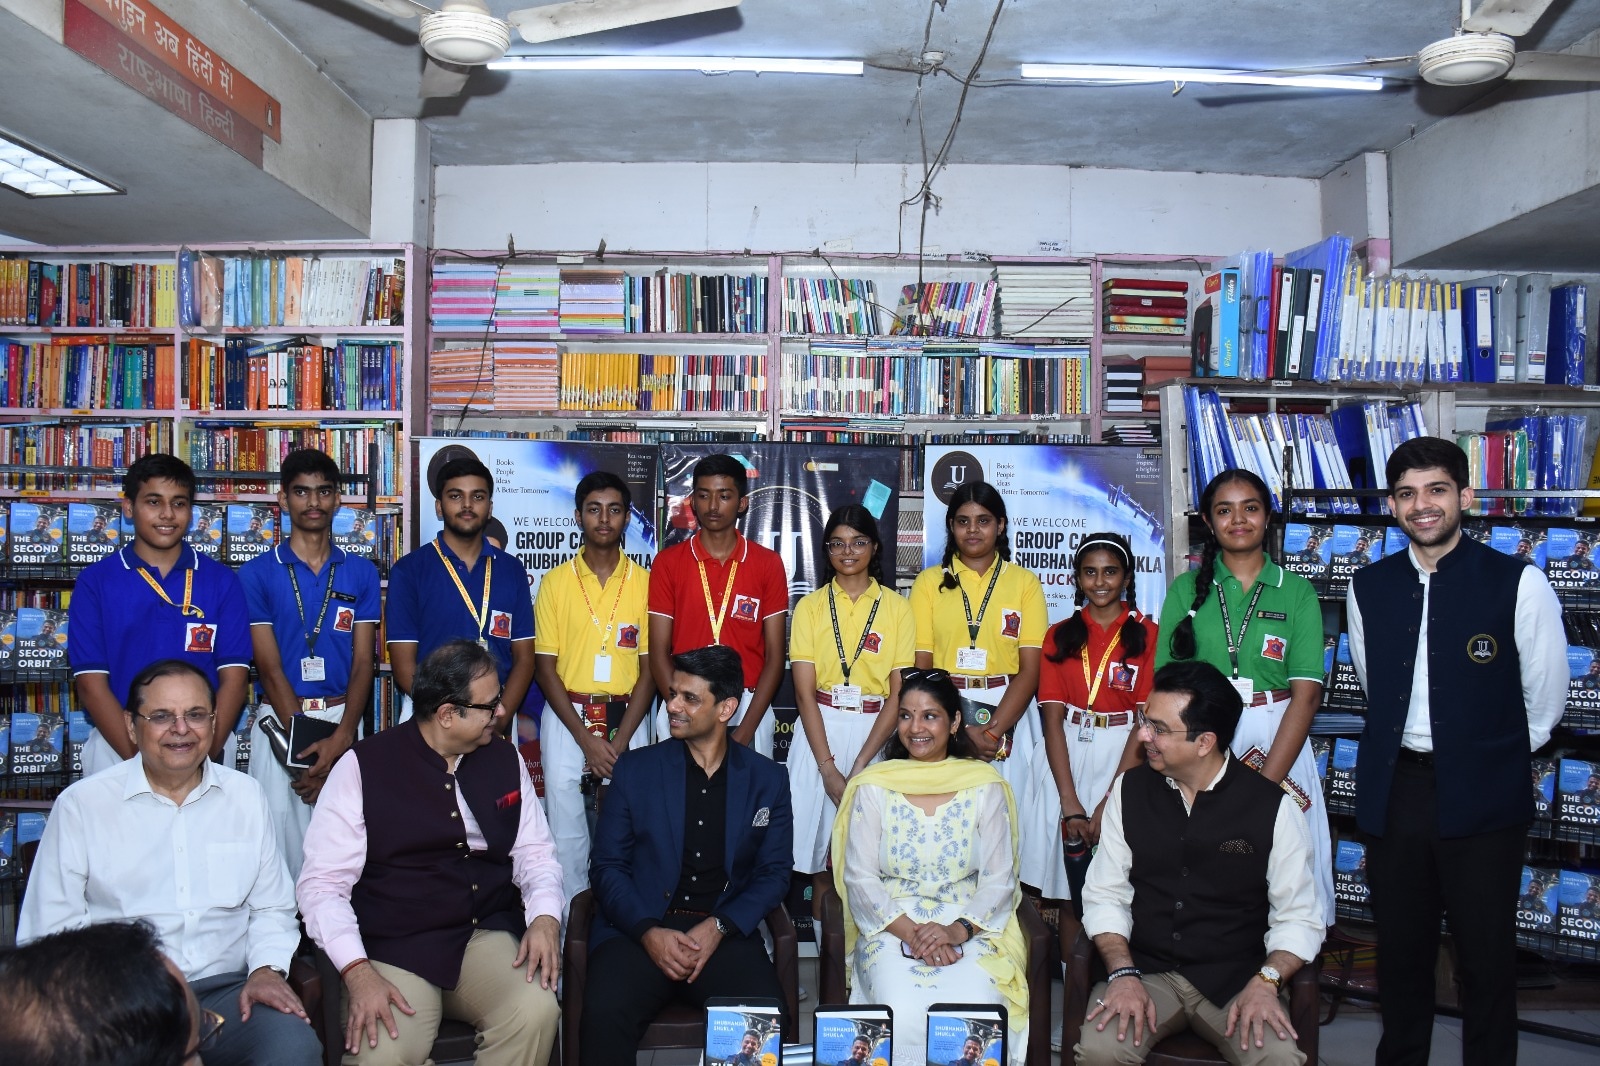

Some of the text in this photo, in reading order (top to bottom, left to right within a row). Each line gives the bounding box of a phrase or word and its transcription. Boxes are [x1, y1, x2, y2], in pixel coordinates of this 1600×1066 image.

[154, 21, 180, 60] अब
[185, 37, 213, 86] हिंदी
[496, 468, 514, 476] People
[950, 466, 967, 484] U
[514, 517, 578, 527] WE WELCOM
[1012, 517, 1087, 528] WE WELCOME
[516, 532, 565, 549] GROUP
[1015, 532, 1064, 549] GROUP
[71, 544, 114, 552] SECOND
[231, 544, 270, 552] SECOND
[1285, 564, 1325, 573] SECOND
[1549, 570, 1598, 579] SECOND
[19, 650, 64, 658] SECOND
[14, 754, 58, 763] SECOND
[13, 765, 47, 773] ORBIT
[1562, 794, 1580, 803] THE
[1561, 907, 1579, 915] THE
